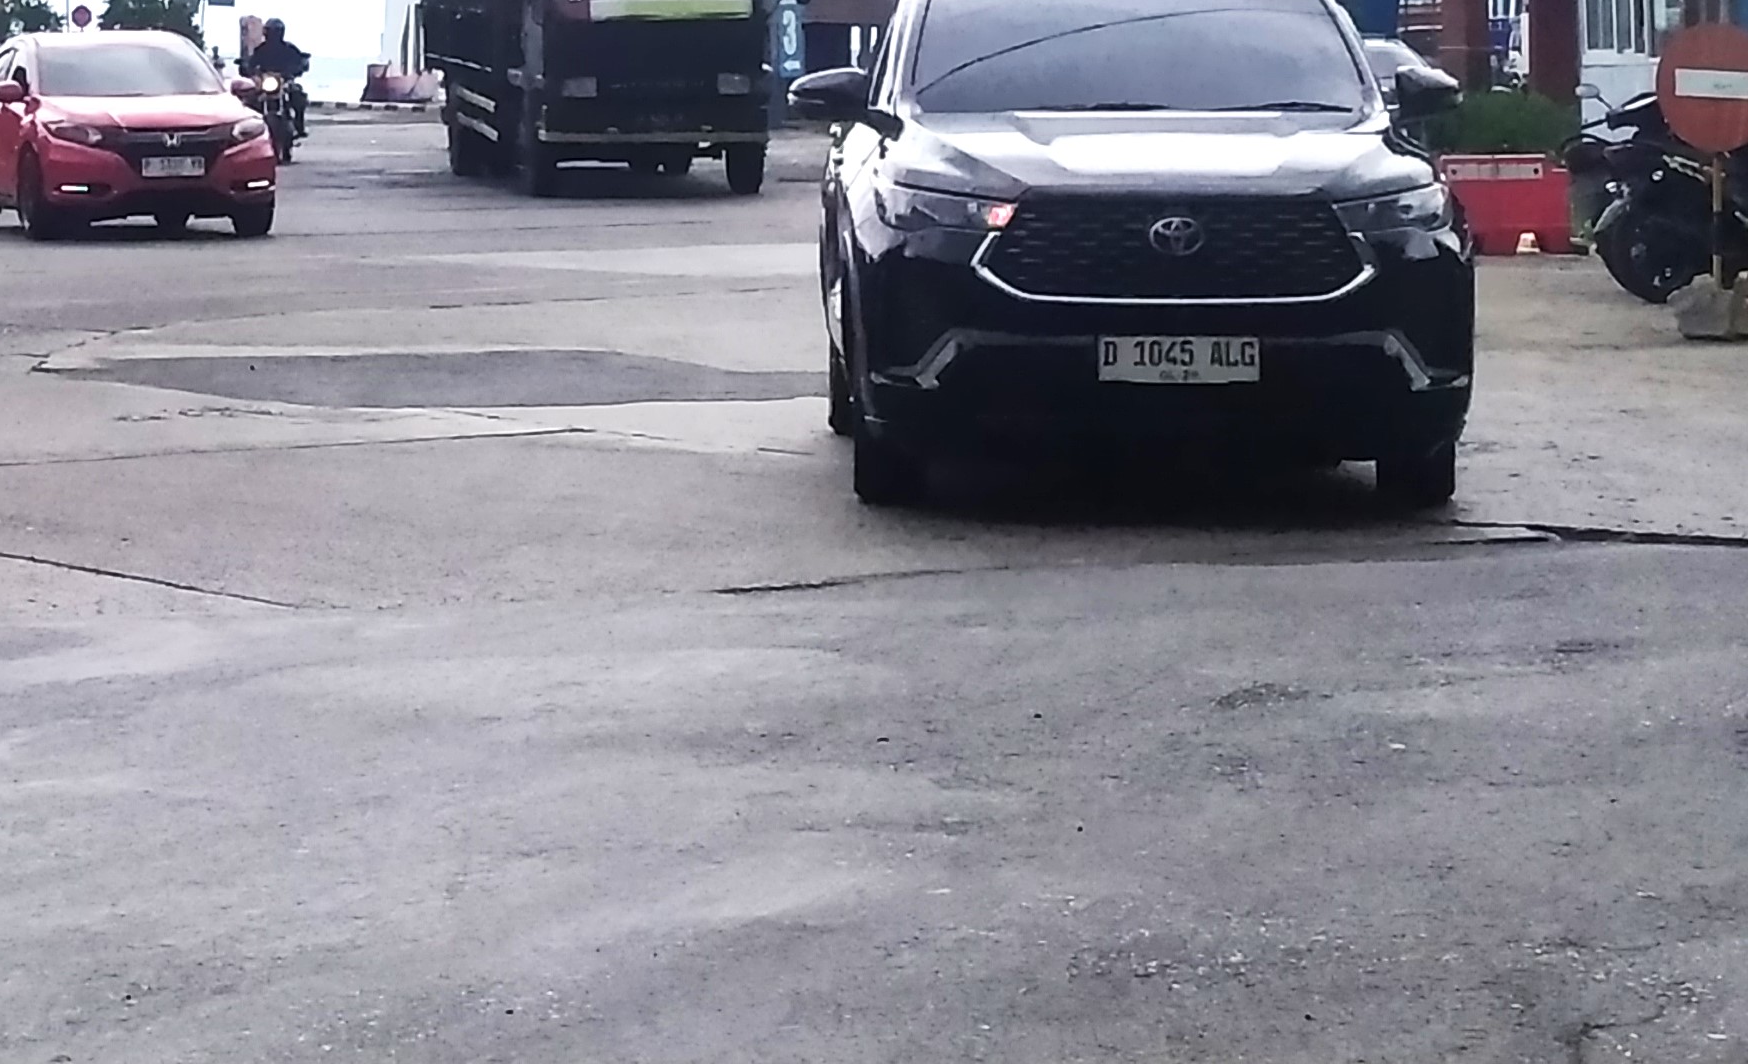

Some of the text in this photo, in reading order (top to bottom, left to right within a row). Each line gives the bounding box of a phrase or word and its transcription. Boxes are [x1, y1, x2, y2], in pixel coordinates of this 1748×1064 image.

[783, 10, 797, 55] 3
[1103, 340, 1255, 366] D 1045 ALG
